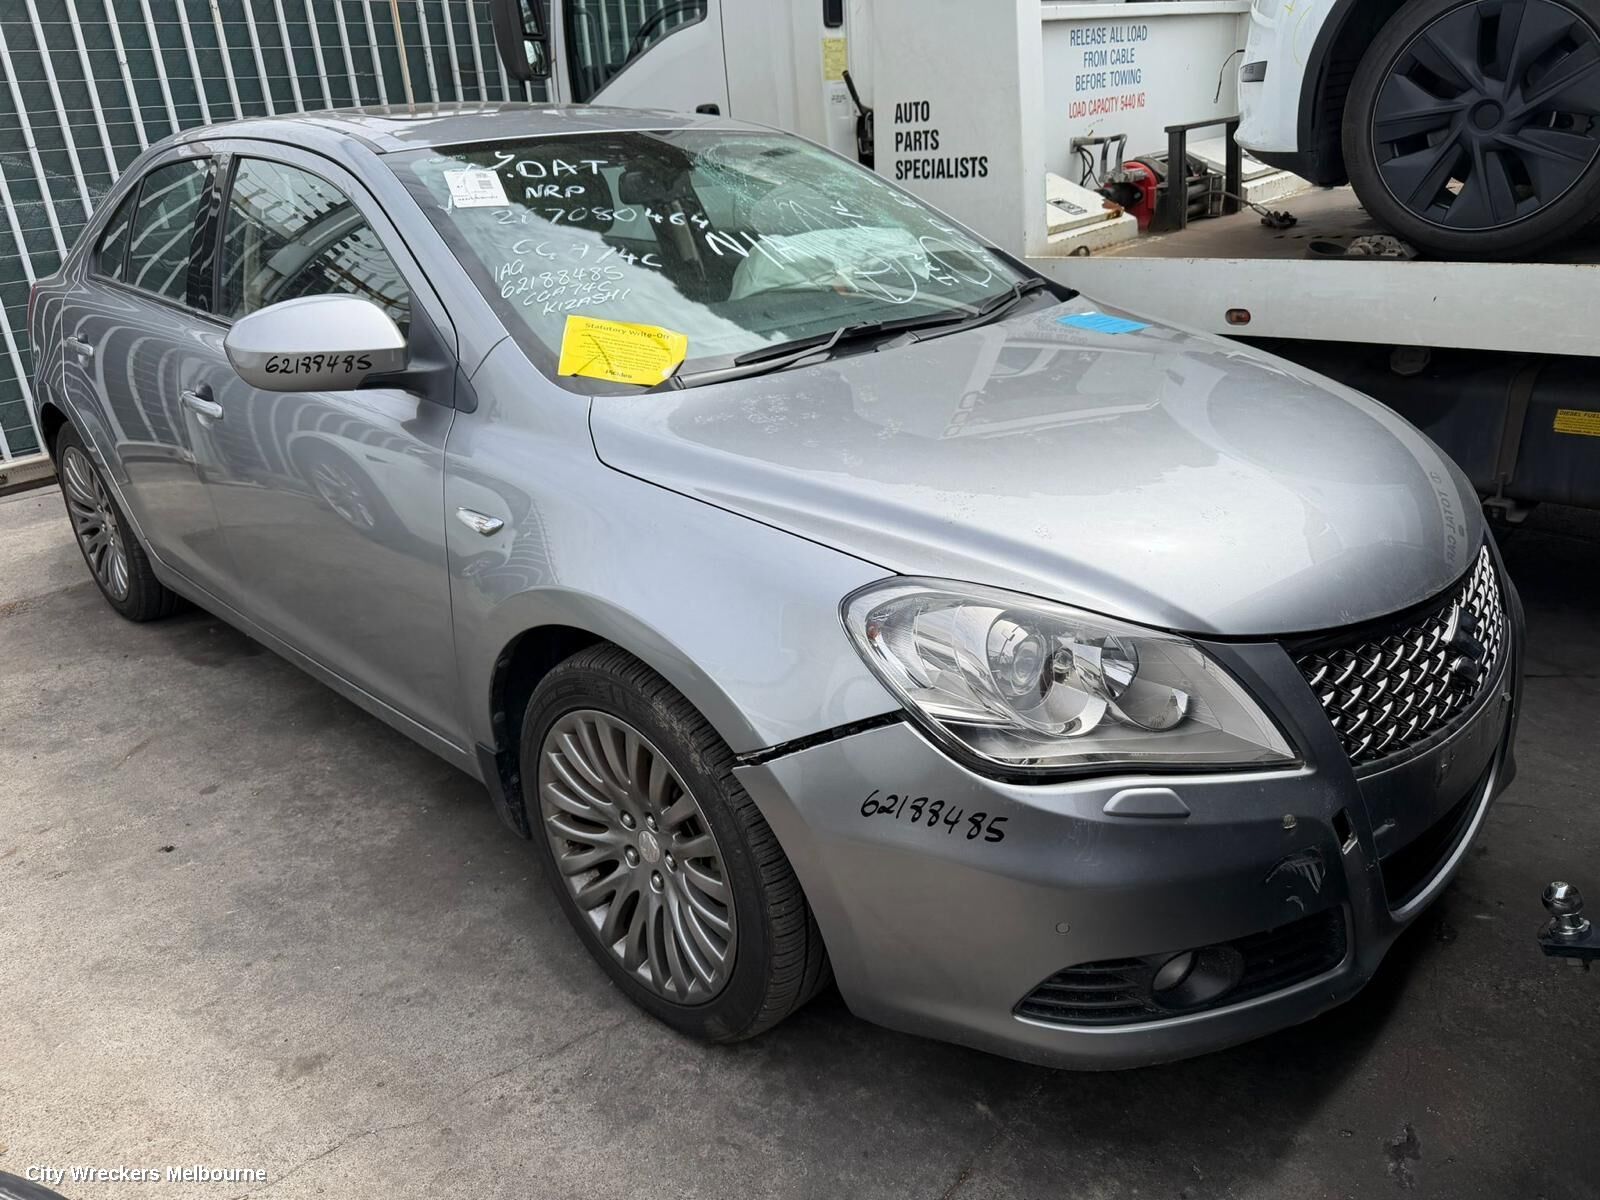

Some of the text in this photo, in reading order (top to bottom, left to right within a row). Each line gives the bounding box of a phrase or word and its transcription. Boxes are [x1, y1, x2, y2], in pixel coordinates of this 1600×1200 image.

[1070, 25, 1148, 46] RELEASE ALL LOAD
[1083, 48, 1135, 68] FROM CABLE
[1075, 68, 1142, 91] BEFORE TOWING
[894, 100, 930, 124] AUTO
[1068, 92, 1146, 119] LOAD CAPACITY 5440 KG
[895, 129, 939, 152] PARTS
[895, 156, 988, 180] SPECIALISTS
[525, 184, 586, 199] NRP
[501, 265, 624, 299] 62188485
[585, 323, 627, 335] Statutory
[265, 354, 372, 375] 62188485
[860, 789, 1008, 843] 62188485
